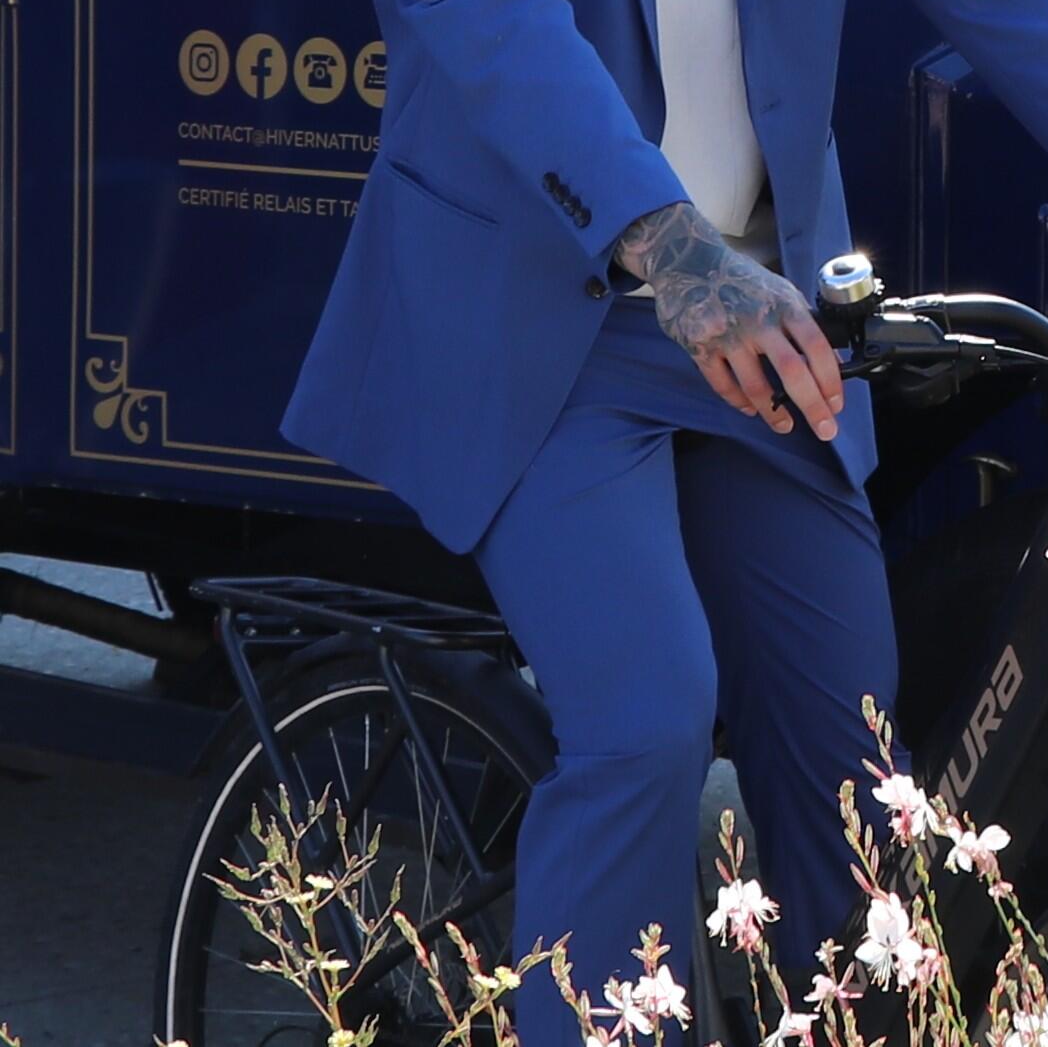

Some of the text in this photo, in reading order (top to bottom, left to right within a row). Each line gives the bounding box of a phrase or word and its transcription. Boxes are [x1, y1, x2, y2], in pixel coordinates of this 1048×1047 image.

[177, 187, 250, 210] CERTIFIÉ
[253, 192, 312, 215] RELAIS
[315, 197, 337, 217] ET
